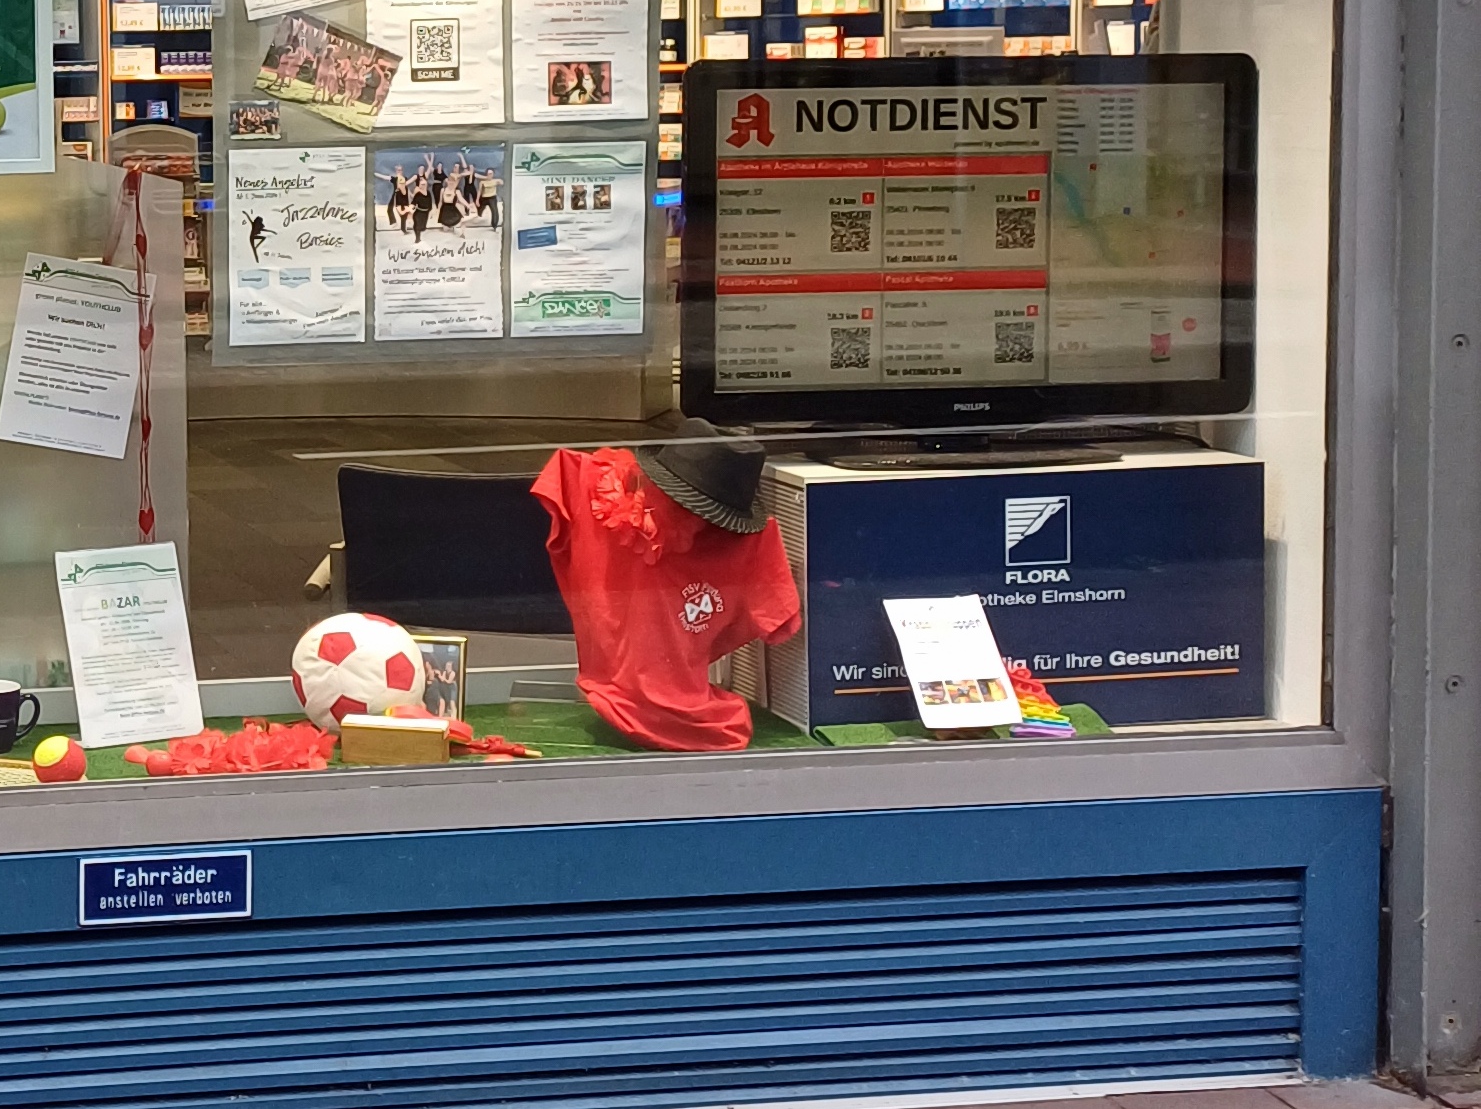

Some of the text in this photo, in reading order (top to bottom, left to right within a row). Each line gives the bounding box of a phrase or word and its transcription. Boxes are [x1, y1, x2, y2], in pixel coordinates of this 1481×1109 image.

[417, 70, 455, 79] SCAN ME
[795, 96, 1047, 133] NOTDIENST
[388, 249, 410, 262] Wir
[1005, 569, 1070, 584] FLORA
[101, 596, 140, 609] BAZAR
[979, 587, 1125, 606] otheke Elmshorn
[833, 664, 868, 681] Wir
[1033, 653, 1062, 670] für
[1066, 652, 1103, 670] Ihre
[1109, 644, 1240, 668] Gesundheit!
[114, 865, 217, 888] Fahrräder
[99, 888, 232, 910] anstellen verboten
